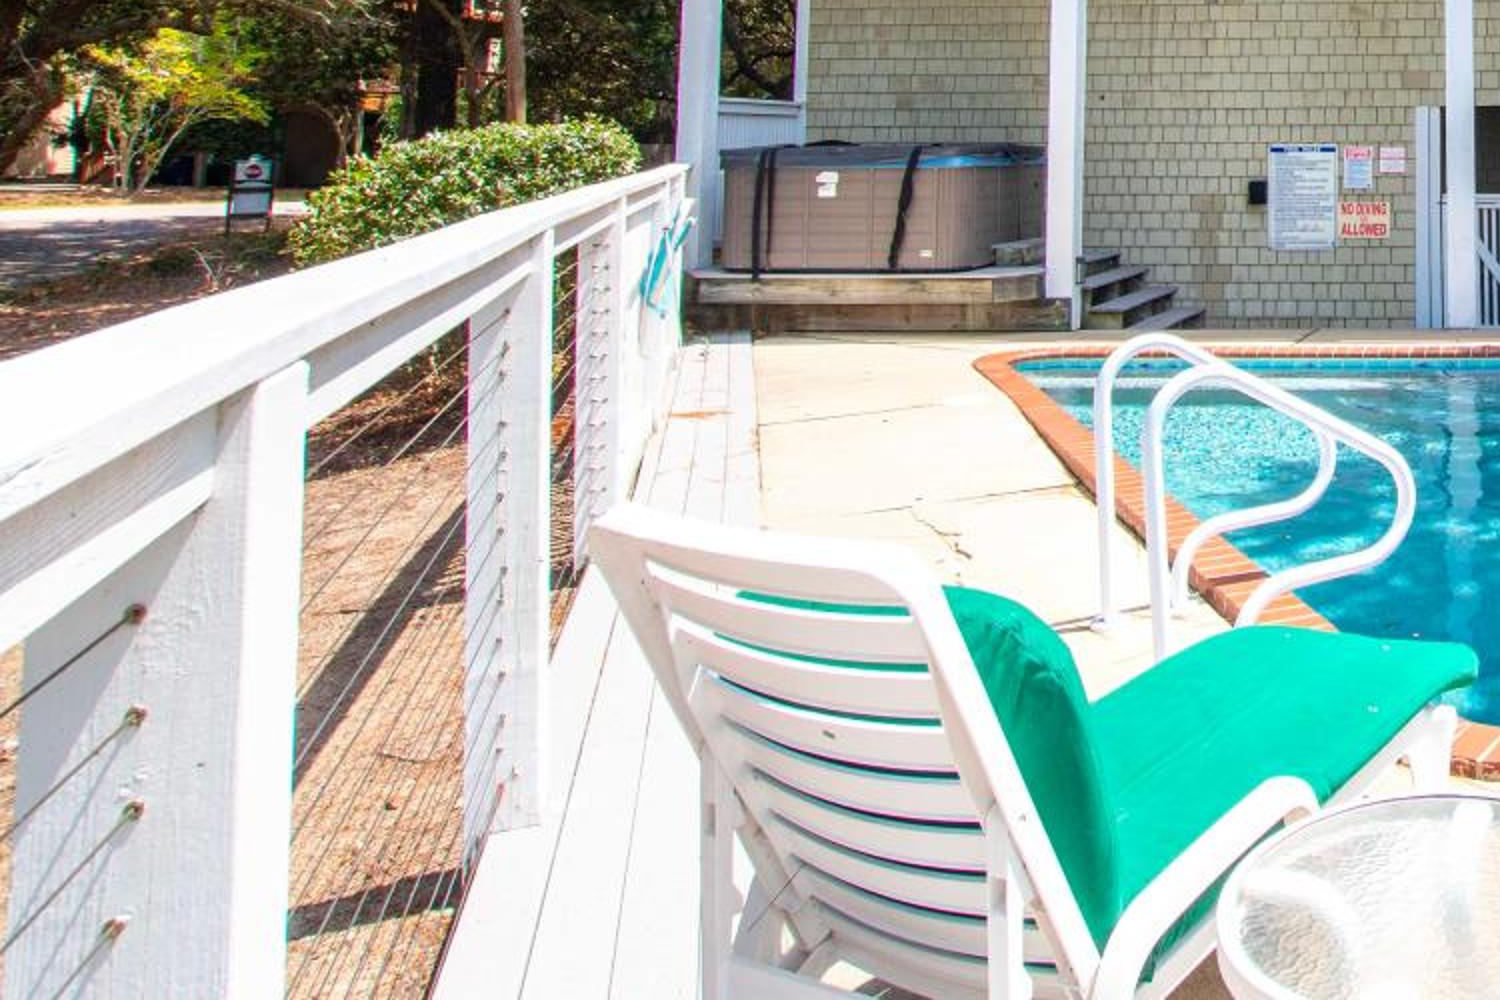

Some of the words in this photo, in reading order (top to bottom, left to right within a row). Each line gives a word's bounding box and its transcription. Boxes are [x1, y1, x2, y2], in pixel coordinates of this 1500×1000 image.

[1341, 203, 1354, 215] NO
[1356, 203, 1387, 215] DIVING
[1341, 223, 1387, 236] ALLOWED
